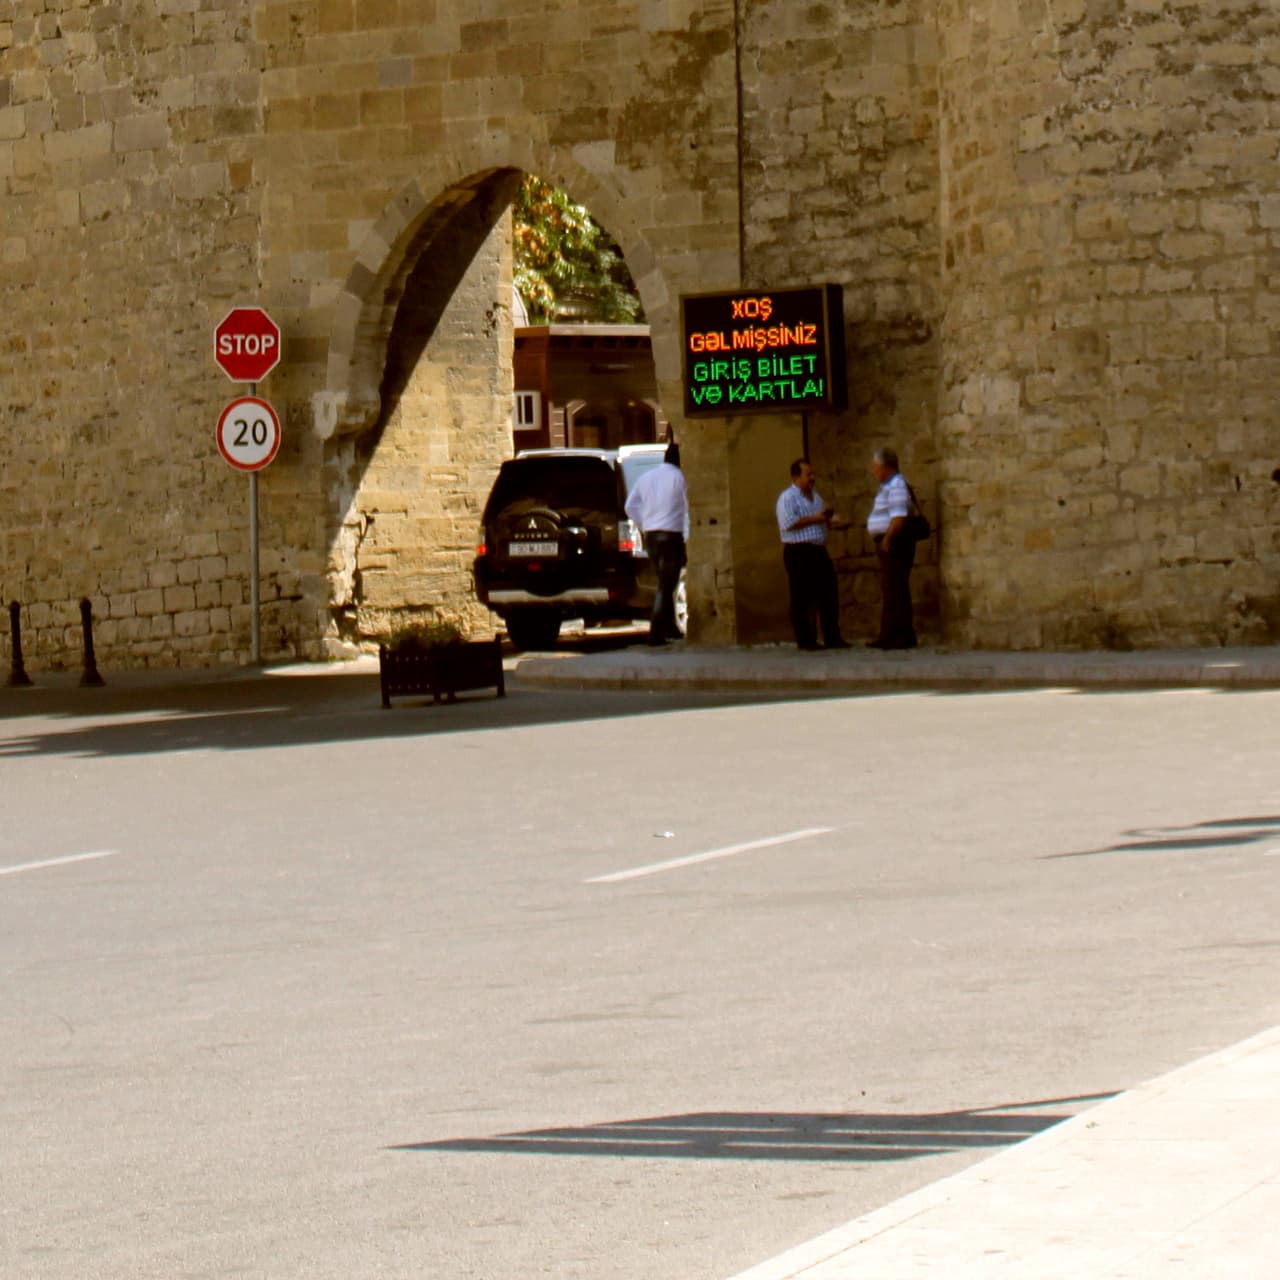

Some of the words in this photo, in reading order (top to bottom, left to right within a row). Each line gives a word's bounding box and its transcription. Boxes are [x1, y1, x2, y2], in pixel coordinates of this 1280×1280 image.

[732, 298, 772, 320] XOŞ
[219, 334, 275, 355] STOP
[694, 357, 751, 382] GİRİŞ
[758, 354, 817, 377] BİLET
[691, 385, 722, 405] VƏ
[233, 419, 267, 446] 20
